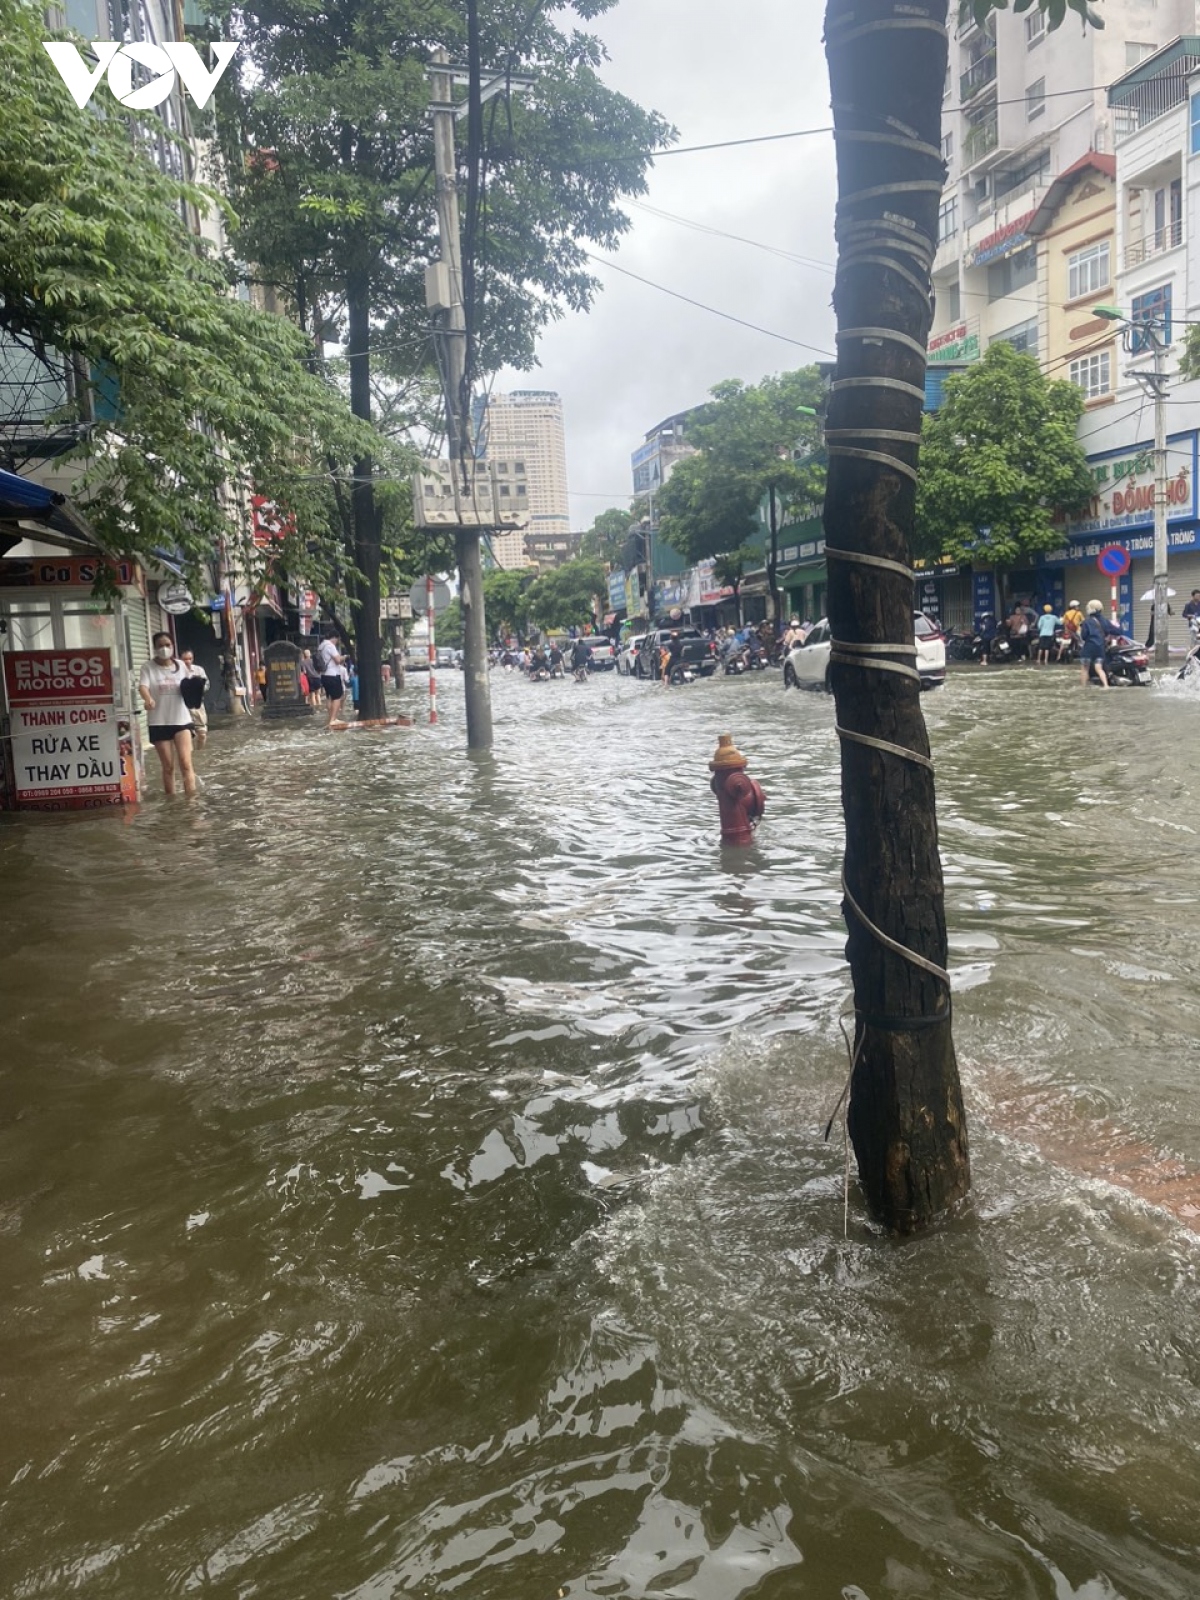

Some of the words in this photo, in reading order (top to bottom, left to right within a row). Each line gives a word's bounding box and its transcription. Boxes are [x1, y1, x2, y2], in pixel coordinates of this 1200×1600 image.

[1171, 529, 1195, 546] TRÒNG
[15, 657, 104, 679] ENEOS
[17, 676, 75, 691] MOTOR
[80, 676, 105, 688] OIL
[32, 733, 72, 755] RỬA
[77, 734, 100, 752] XE
[24, 764, 70, 782] THAY
[77, 756, 114, 779] DẦU
